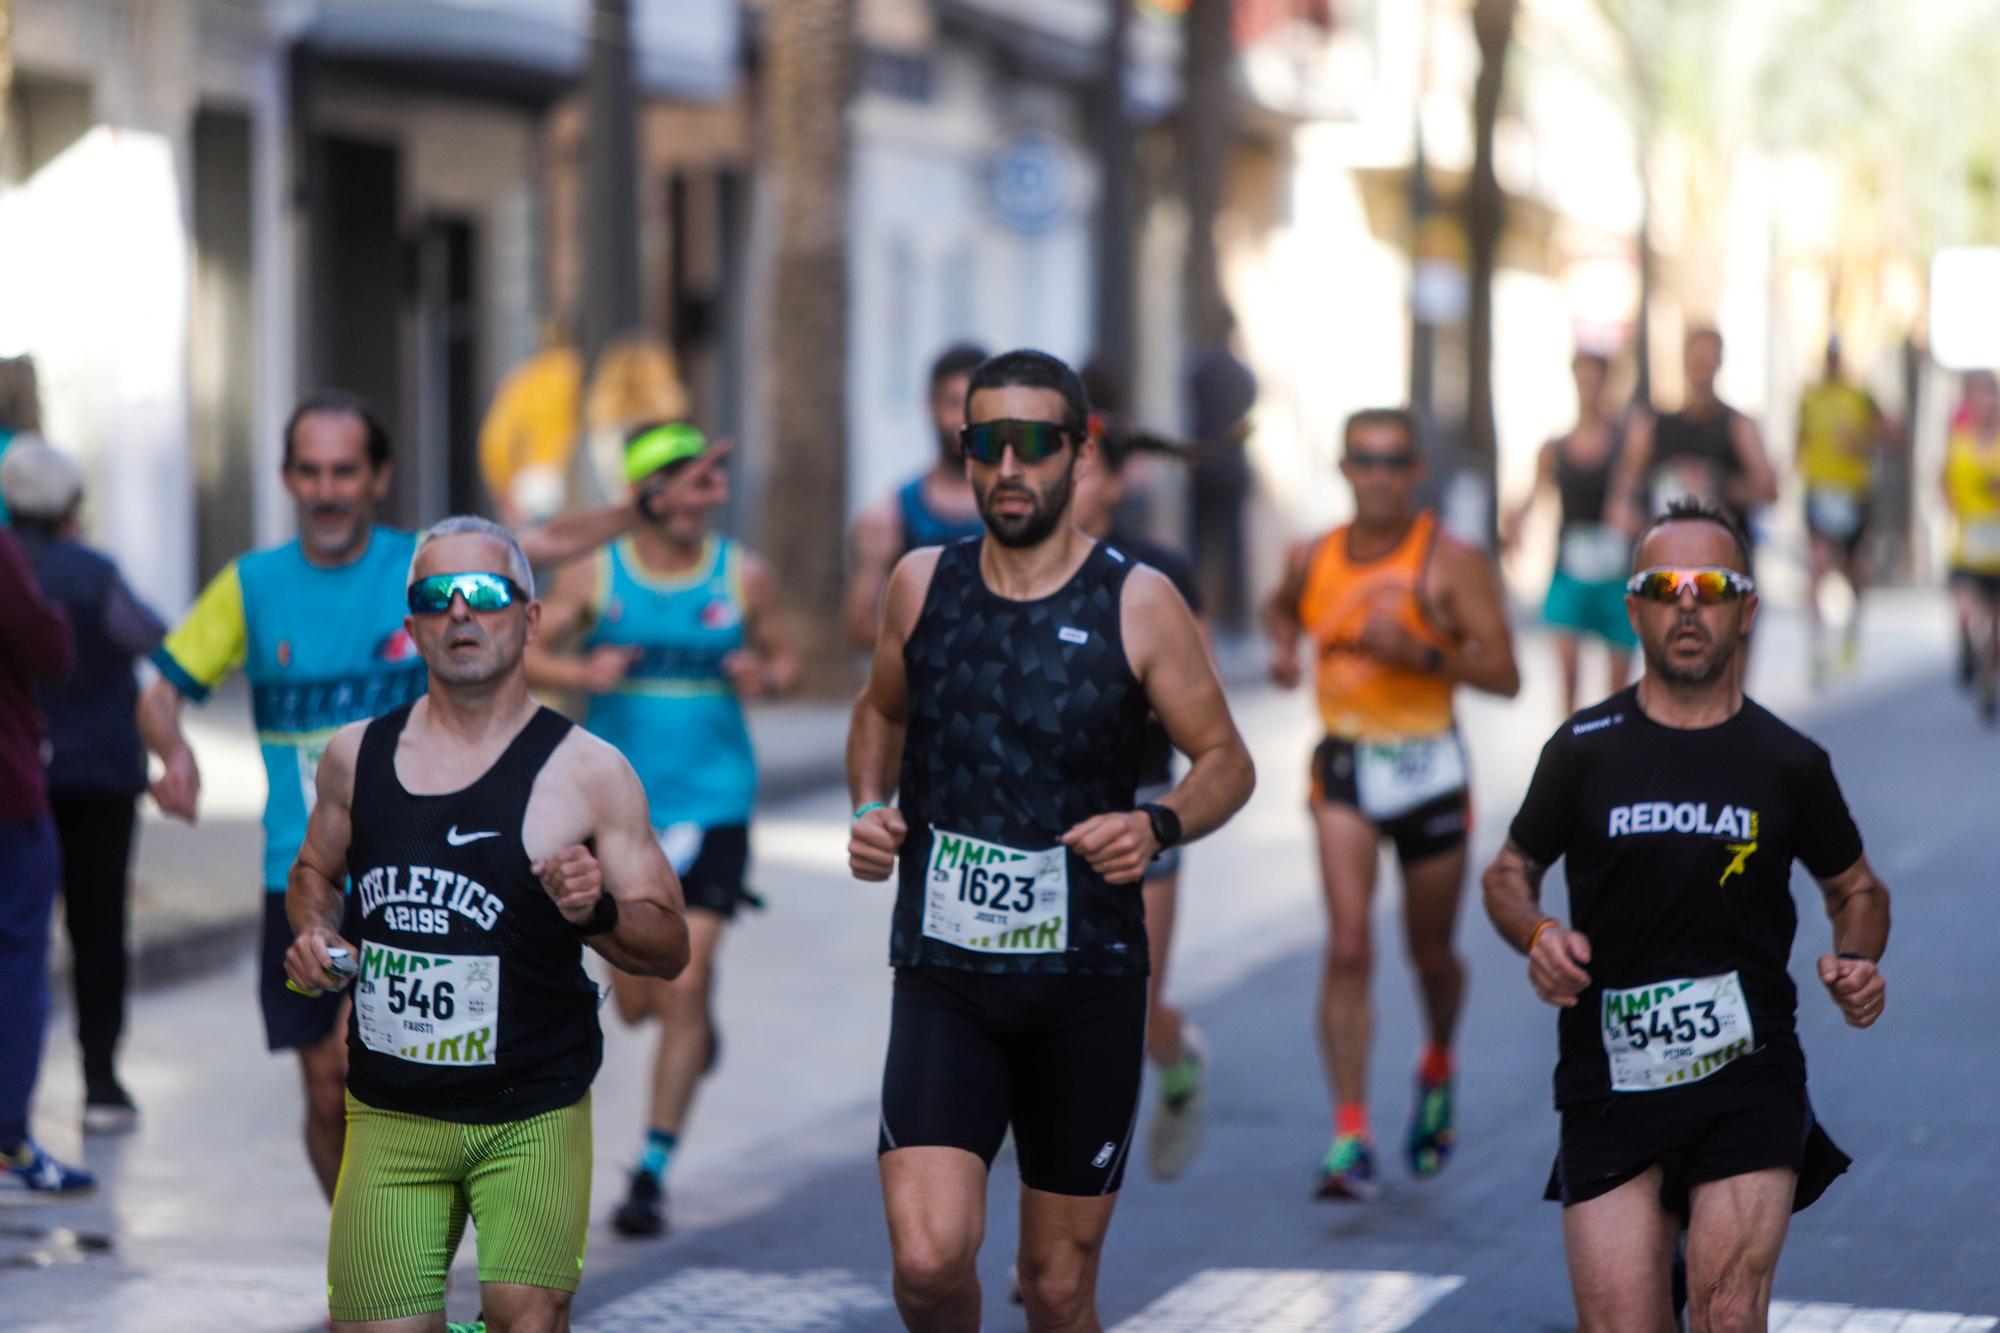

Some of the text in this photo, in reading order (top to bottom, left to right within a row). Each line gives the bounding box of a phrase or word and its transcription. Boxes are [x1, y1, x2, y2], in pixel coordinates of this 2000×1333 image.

[1609, 802, 1751, 840] REDOLAT
[933, 834, 1029, 871] MM
[958, 863, 1036, 913] 1623
[384, 905, 449, 935] 42195
[360, 944, 453, 983] MM
[388, 973, 455, 1020] 546
[1604, 981, 1695, 1031] MM
[1625, 1000, 1720, 1049] 5453
